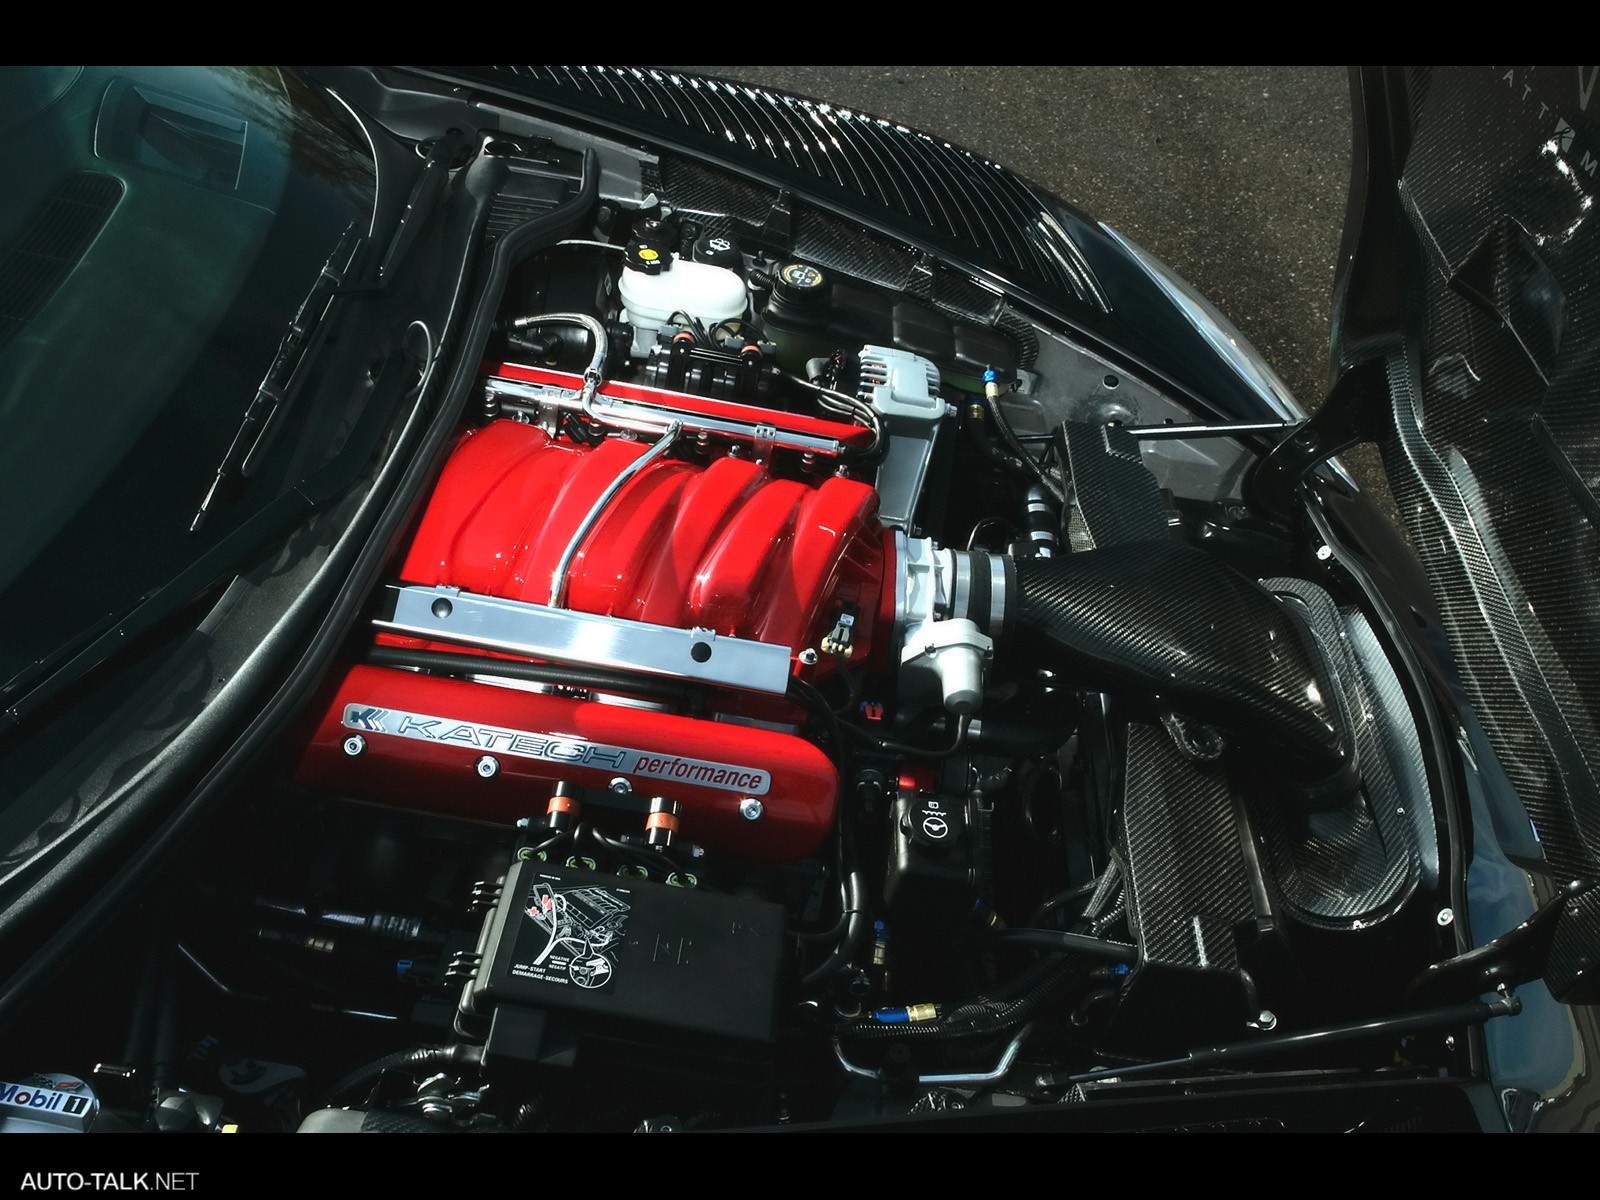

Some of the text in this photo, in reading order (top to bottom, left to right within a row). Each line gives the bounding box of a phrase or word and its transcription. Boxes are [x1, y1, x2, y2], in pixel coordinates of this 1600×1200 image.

[398, 716, 625, 768] KATECH
[632, 756, 763, 790] performance
[512, 970, 569, 984] DEMARRAGE-SECOURS
[514, 964, 546, 973] JUMP-START
[0, 1083, 63, 1110] Mobil
